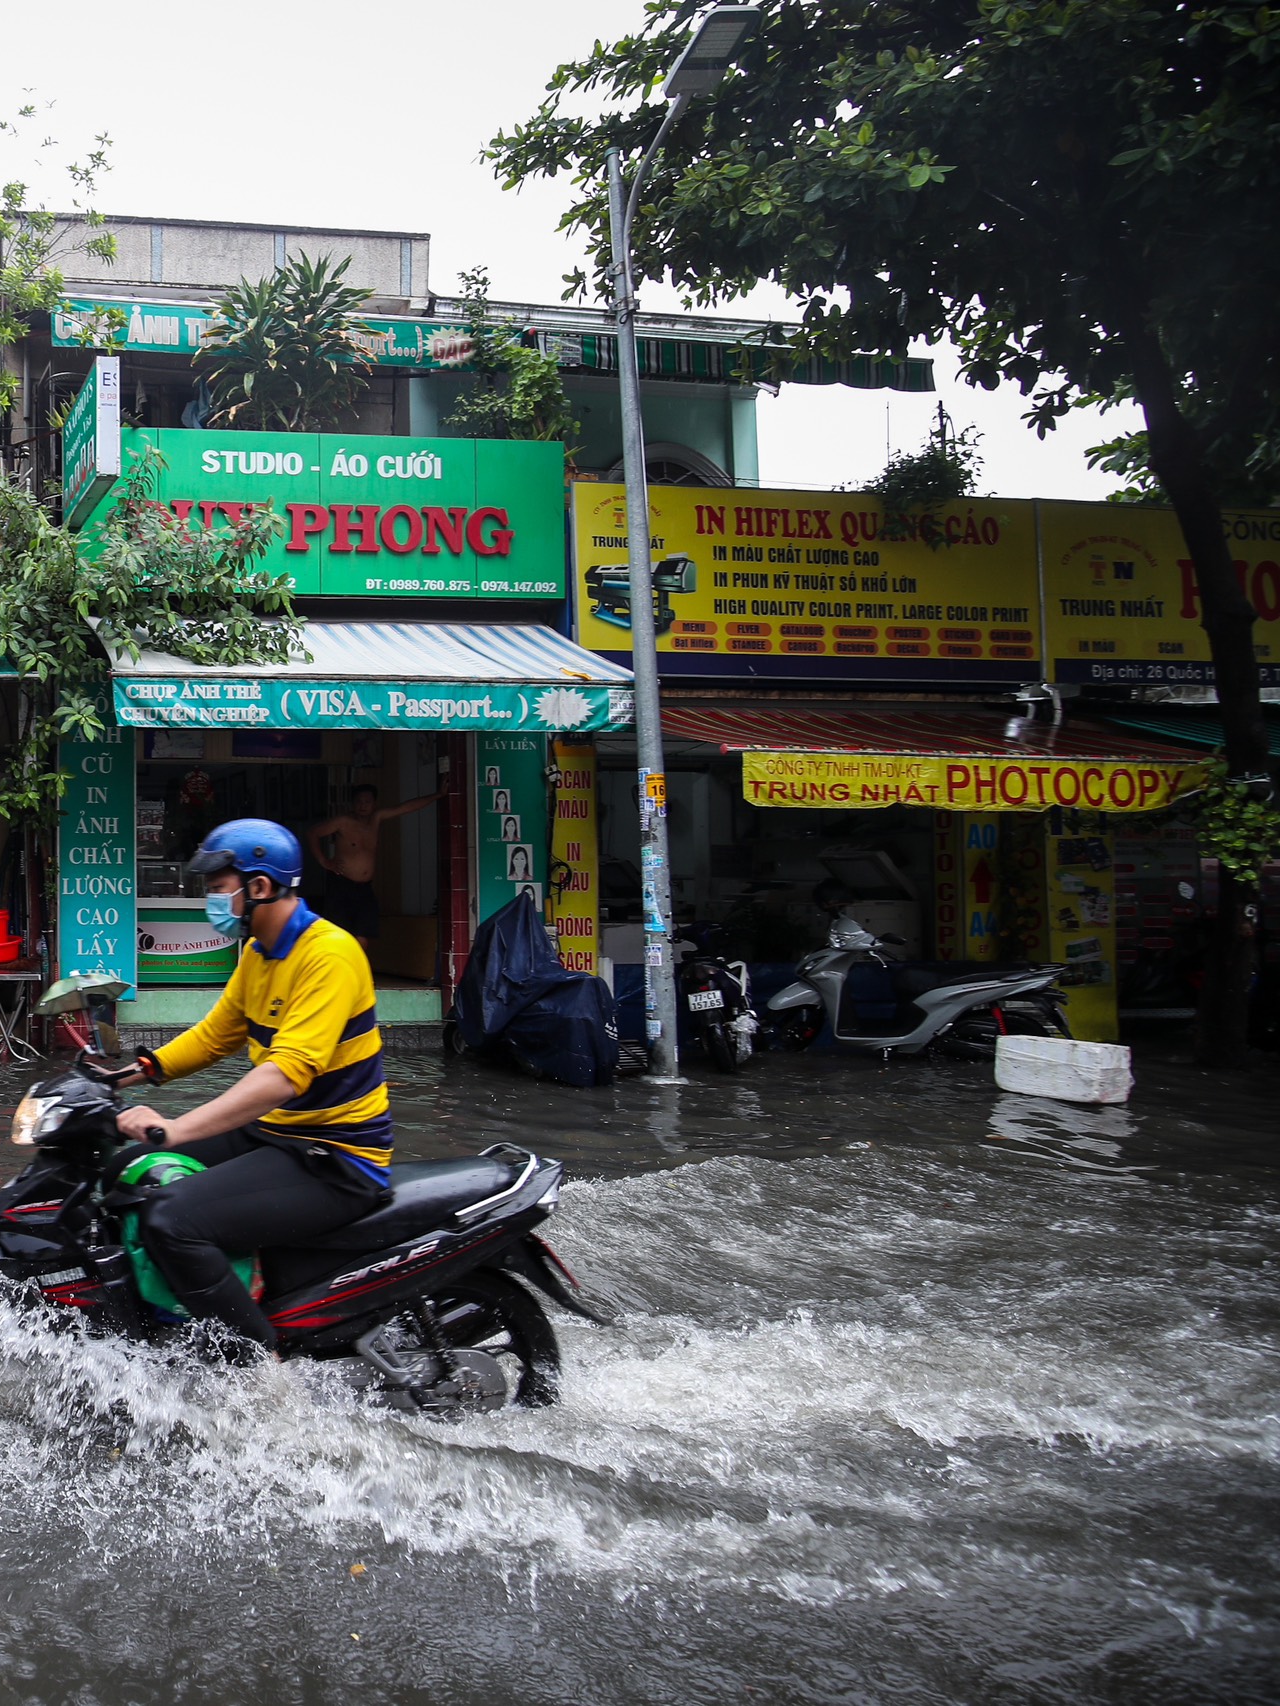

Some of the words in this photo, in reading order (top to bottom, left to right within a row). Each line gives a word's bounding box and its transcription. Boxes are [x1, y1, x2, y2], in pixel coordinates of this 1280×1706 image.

[127, 305, 179, 346] ẢNH
[200, 449, 303, 476] STUDIO
[330, 448, 368, 477] ÁO
[376, 451, 442, 479] CƯỚI
[285, 503, 515, 556] PHONG
[694, 504, 726, 535] IN
[734, 507, 833, 540] HIFLEX
[732, 544, 763, 562] MÀU
[768, 543, 802, 563] CHẤT
[806, 548, 849, 568] LƯỢNG
[853, 550, 880, 566] CAO
[389, 579, 470, 591] 0989.760.875
[481, 581, 557, 593] 0974.147.092
[713, 571, 728, 587] IN
[733, 572, 768, 588] PHUN
[794, 572, 835, 594] THUẬT
[839, 571, 857, 591] SỐ
[862, 571, 888, 593] KHỔ
[892, 575, 917, 593] LỚN
[714, 599, 746, 615] HIGH
[751, 600, 805, 617] QUALITY
[809, 601, 851, 617] COLOR
[902, 604, 942, 620] LARGE
[946, 605, 988, 621] COLOR
[992, 607, 1029, 622] PRINT
[1060, 598, 1115, 617] TRUNG
[1120, 595, 1164, 617] NHẤT
[682, 622, 706, 632] MENU
[737, 624, 759, 634] FLYER
[1091, 665, 1114, 681] Địa
[1146, 665, 1163, 679] 26
[1166, 663, 1202, 681] Quốc
[125, 683, 177, 702] CHỤP
[180, 681, 221, 699] ẢNH
[223, 681, 262, 699] THẺ
[119, 704, 196, 722] CHUYÊN
[200, 704, 270, 726] NGHIỆP
[297, 690, 366, 717] VISA
[485, 735, 508, 750] LẤY
[511, 735, 537, 751] LIỀN
[81, 752, 113, 774] CŨ
[766, 757, 804, 776] CÔNG
[806, 760, 822, 776] TY
[825, 762, 860, 778] TNHH
[863, 762, 923, 779] TM-DV-KT
[556, 770, 591, 789] SCAN
[652, 785, 665, 796] 16
[946, 763, 1184, 808] PHOTOCOPY
[87, 786, 108, 803] IN
[748, 780, 850, 801] TRUNG
[861, 780, 940, 803] NHẤT
[558, 795, 588, 819] MÀU
[75, 810, 119, 834] ẢNH
[967, 824, 996, 849] A0
[68, 841, 126, 865] CHẤT
[567, 842, 581, 861] IN
[62, 873, 133, 898] LƯỢNG
[560, 867, 589, 891] MÀU
[76, 907, 119, 926] CAO
[557, 913, 593, 936] ĐÓNG
[970, 911, 998, 937] A4
[76, 930, 119, 955] LẤY
[154, 942, 180, 953] CHỤP
[183, 940, 202, 950] ẢNH
[559, 947, 593, 971] SÁCH
[691, 998, 722, 1010] 157.65
[693, 991, 717, 1002] 77-C1
[328, 1239, 440, 1290] SIRIUS
